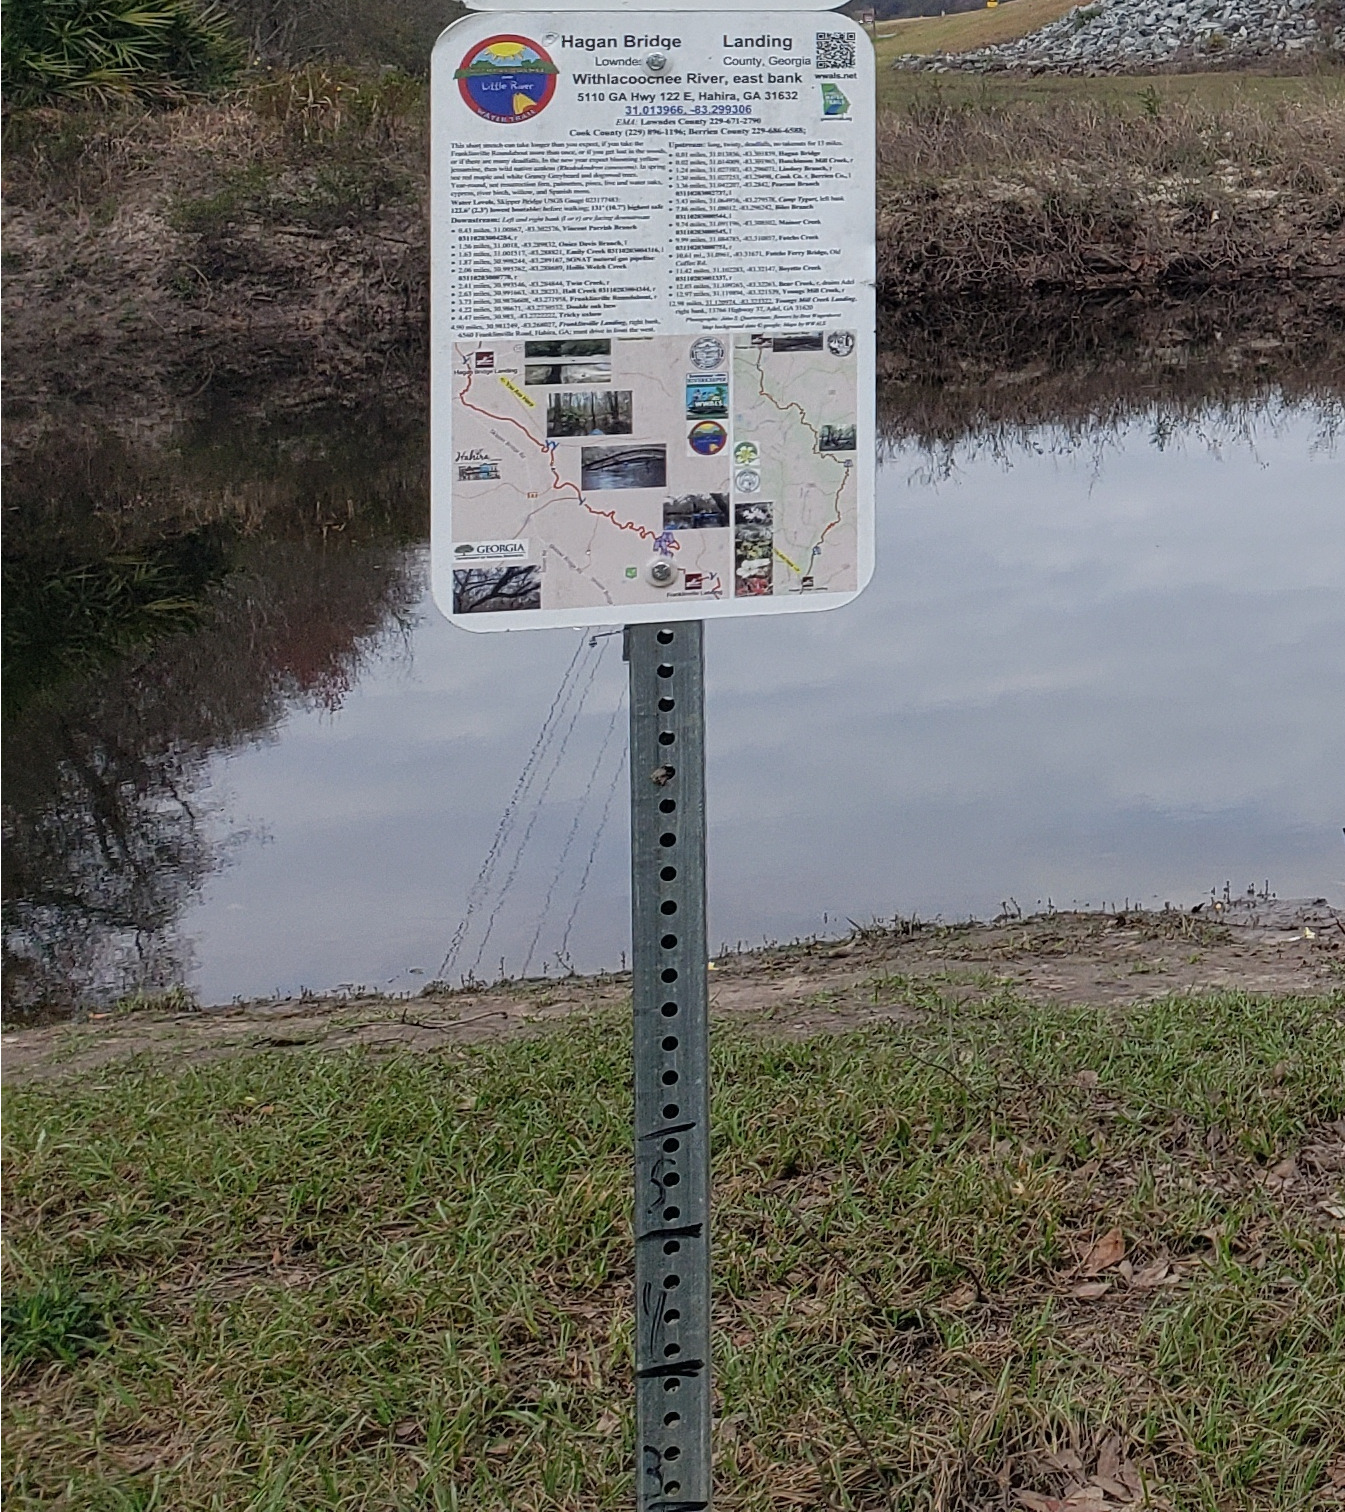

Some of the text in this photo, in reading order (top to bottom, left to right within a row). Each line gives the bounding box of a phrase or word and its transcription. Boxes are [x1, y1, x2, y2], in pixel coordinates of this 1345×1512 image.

[562, 34, 793, 51] Hagan Bridge Landing
[723, 57, 765, 67] County,
[769, 57, 811, 67] Georgia
[572, 73, 802, 86] Withlacoochee River, east bank
[577, 91, 798, 103] 5110 GA Hwy 122 E, Hahira, GA 31632
[625, 105, 752, 116] 31.013966, -83.299306
[678, 118, 707, 126] County
[594, 129, 623, 138] County
[720, 128, 749, 136] County
[477, 544, 524, 554] GEORGIA
